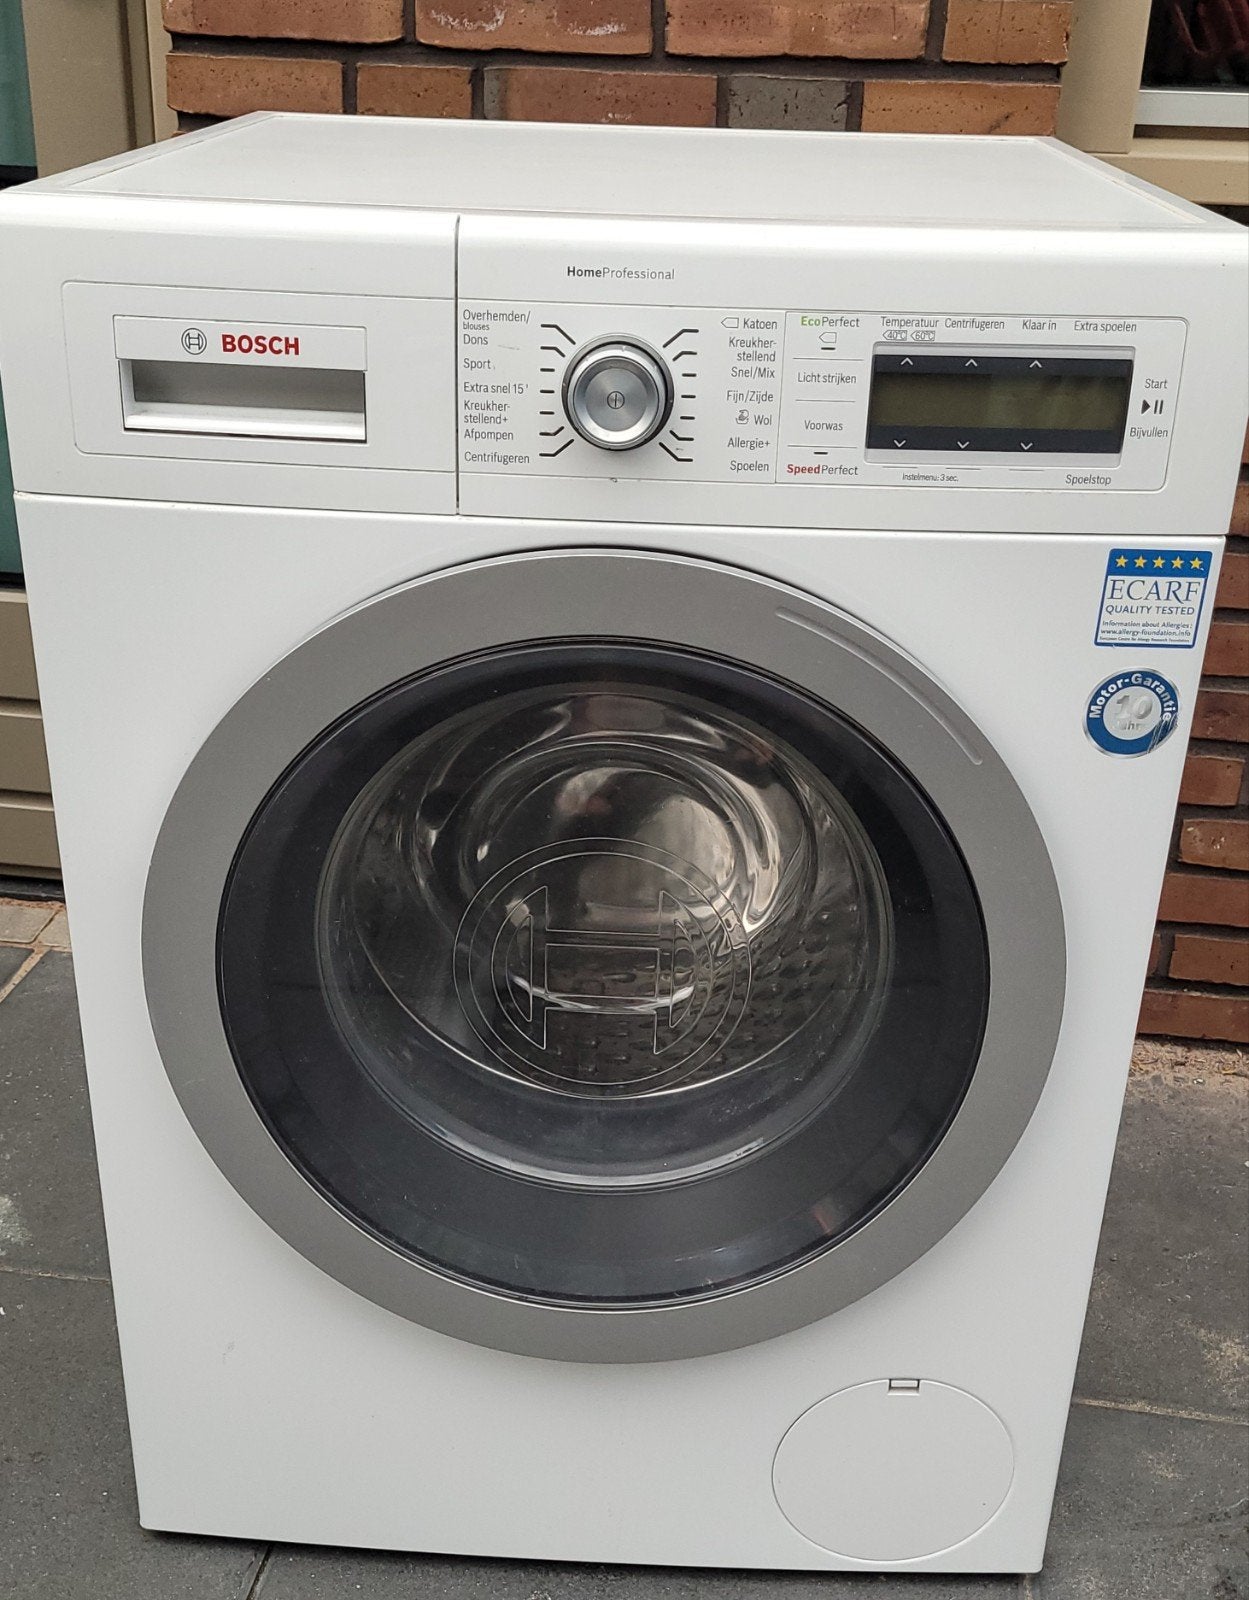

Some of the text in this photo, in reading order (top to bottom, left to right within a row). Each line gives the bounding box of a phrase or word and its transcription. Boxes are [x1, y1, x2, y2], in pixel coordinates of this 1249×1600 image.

[567, 266, 675, 280] HomeProfessional
[463, 309, 531, 324] Overhemden/
[801, 316, 860, 327] EcoPerfect
[463, 322, 490, 331] blouses
[743, 318, 777, 329] Katoen
[880, 316, 1137, 333] Temperatuur Centrifugeren Klaar in Extra spoelen
[463, 334, 489, 345] Dons
[915, 331, 934, 341] 60°C
[222, 334, 300, 355] BOSCH
[729, 337, 777, 348] Kreukher-
[737, 351, 776, 362] stellend
[463, 358, 491, 371] Sport
[731, 367, 775, 379] Snel/Mix
[797, 372, 857, 385] Licht strijken
[464, 382, 489, 393] Extra
[491, 383, 511, 394] snel
[1144, 378, 1168, 389] Start
[726, 390, 774, 403] Fijn/Zijde
[464, 400, 511, 412] Kreukher-
[464, 414, 508, 424] stellend+
[754, 415, 772, 425] Wol
[804, 420, 843, 431] Voorwas
[464, 429, 514, 441] Afpompen
[1129, 427, 1168, 439] Bijvullen
[728, 437, 770, 450] Allergie+
[464, 452, 530, 465] Centrifugeren
[730, 461, 769, 473] Spoelen
[787, 464, 858, 476] SpeedPerfect
[1065, 474, 1111, 486] Spoelstop
[1107, 579, 1201, 604] ECARF
[1105, 605, 1195, 615] QUALITY TESTED
[1100, 628, 1191, 638] www.allergy-foundation.info
[1089, 673, 1177, 722] Motor-Garantie
